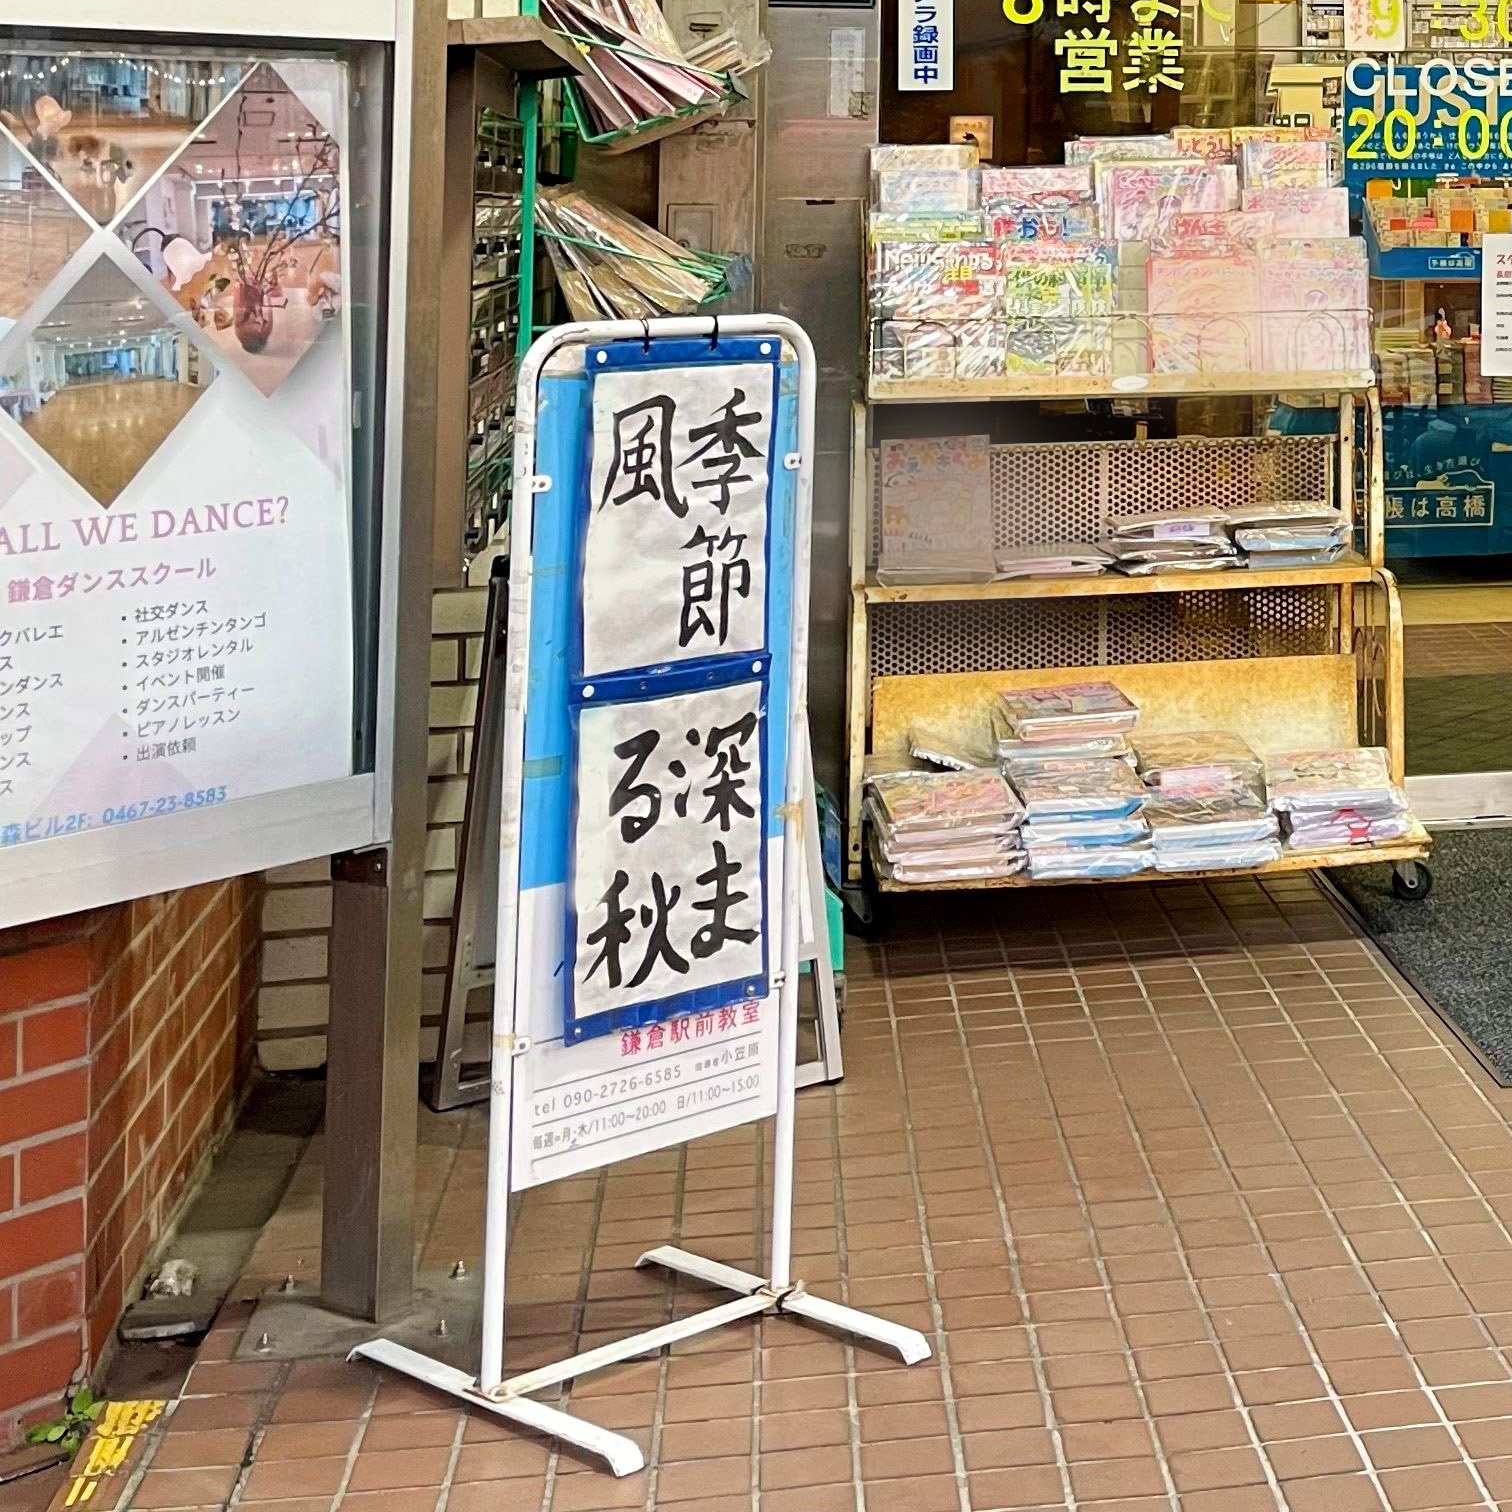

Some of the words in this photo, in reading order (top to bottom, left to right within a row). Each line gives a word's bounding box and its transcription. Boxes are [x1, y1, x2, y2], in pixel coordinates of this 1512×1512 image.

[1054, 28, 1185, 94] 営業
[596, 393, 691, 520] 風
[71, 512, 138, 548] WE
[151, 495, 291, 540] DANCE?
[675, 387, 766, 649] 季節
[1358, 491, 1488, 520] 帳は高橋
[7, 557, 217, 604] 鎌倉ダンススクール
[134, 599, 209, 624] 社交ダンス
[135, 610, 267, 646] アルゼンチンタンゴ
[135, 638, 255, 670] スタジオレンタル
[135, 663, 226, 692] イベント開催
[135, 736, 198, 762] 出演依頼
[101, 784, 229, 825] 0467-23-8583
[620, 999, 762, 1058] 鎌倉駅前教室
[534, 1098, 557, 1118] tel
[563, 1063, 683, 1110] 090-2726-6585
